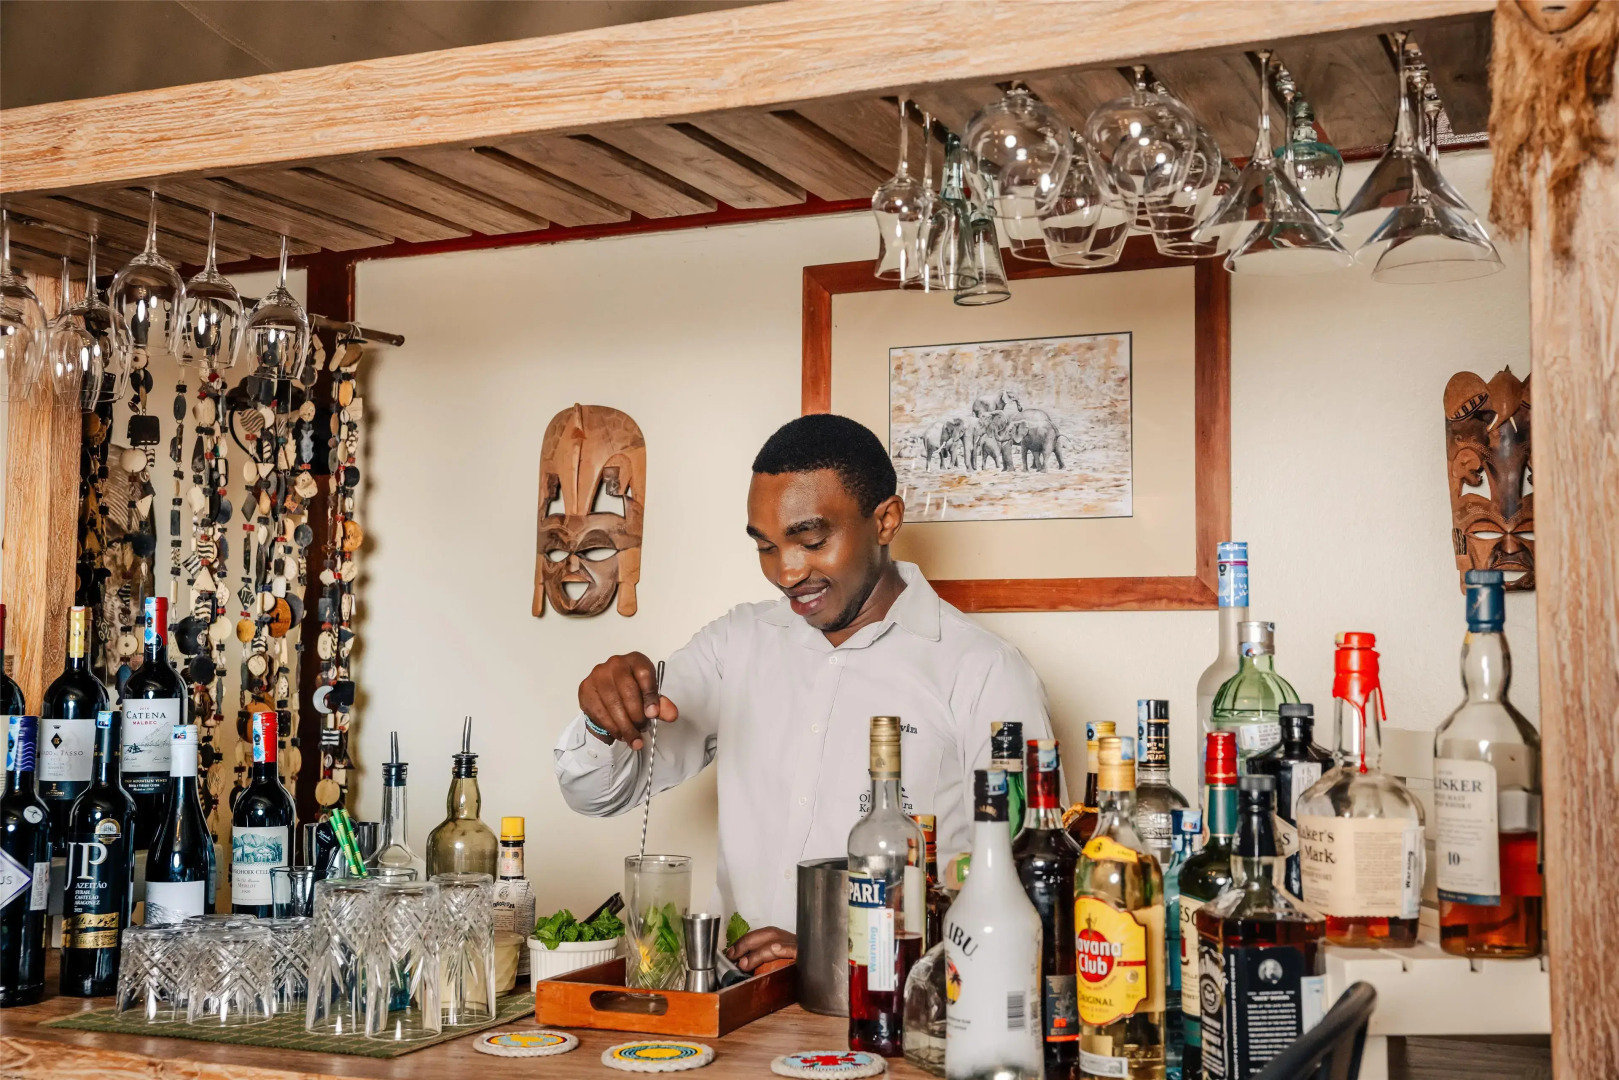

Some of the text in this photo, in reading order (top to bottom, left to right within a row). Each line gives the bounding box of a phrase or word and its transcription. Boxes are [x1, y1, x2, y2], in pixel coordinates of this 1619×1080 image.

[126, 710, 167, 720] CATENA
[1304, 845, 1335, 864] Mark
[1448, 851, 1461, 866] 10
[64, 841, 108, 891] JP
[75, 881, 108, 889] AZEITÃO
[868, 926, 879, 973] Warning
[1078, 953, 1108, 975] Club
